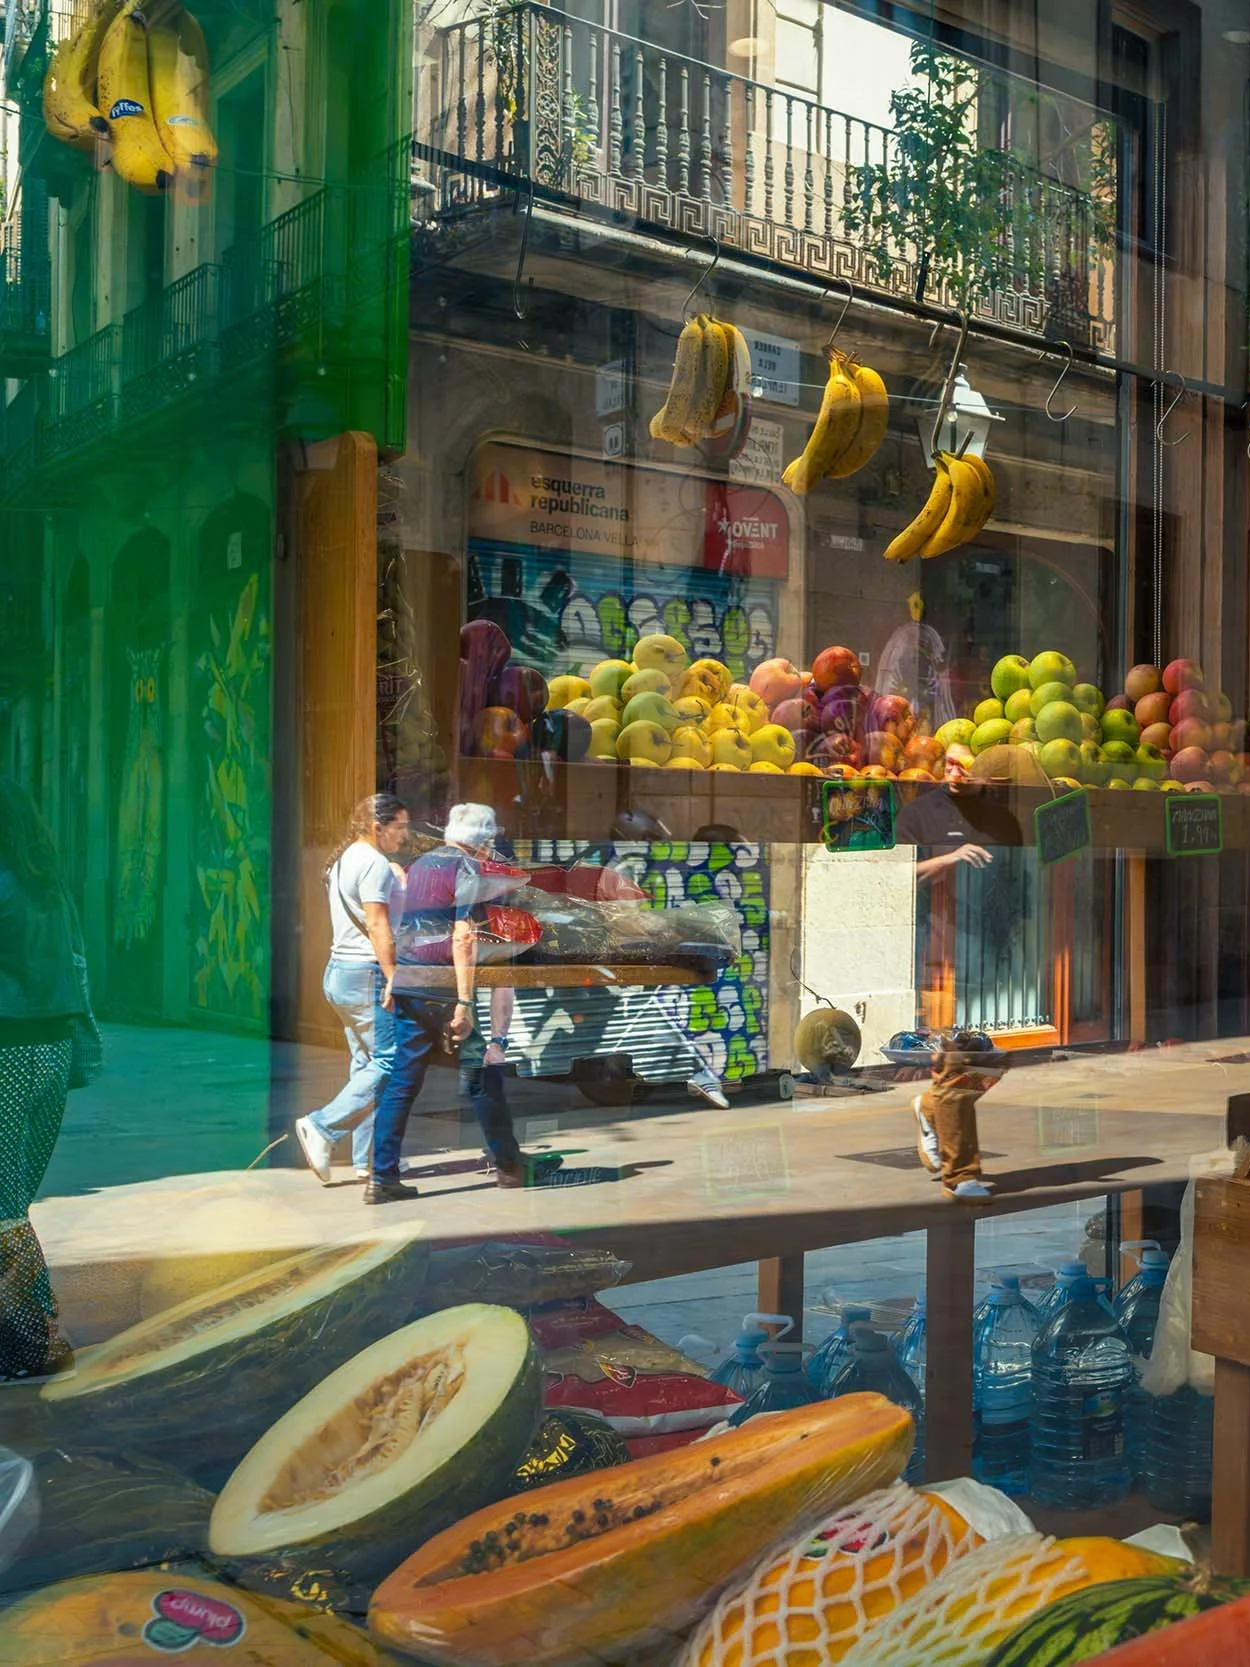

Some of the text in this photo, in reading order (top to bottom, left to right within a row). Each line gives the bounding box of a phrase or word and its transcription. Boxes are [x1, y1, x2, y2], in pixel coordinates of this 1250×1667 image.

[530, 475, 605, 499] esquerra
[530, 494, 630, 522] republicana
[530, 520, 600, 542] BARCELONA
[169, 1597, 234, 1630] plump
